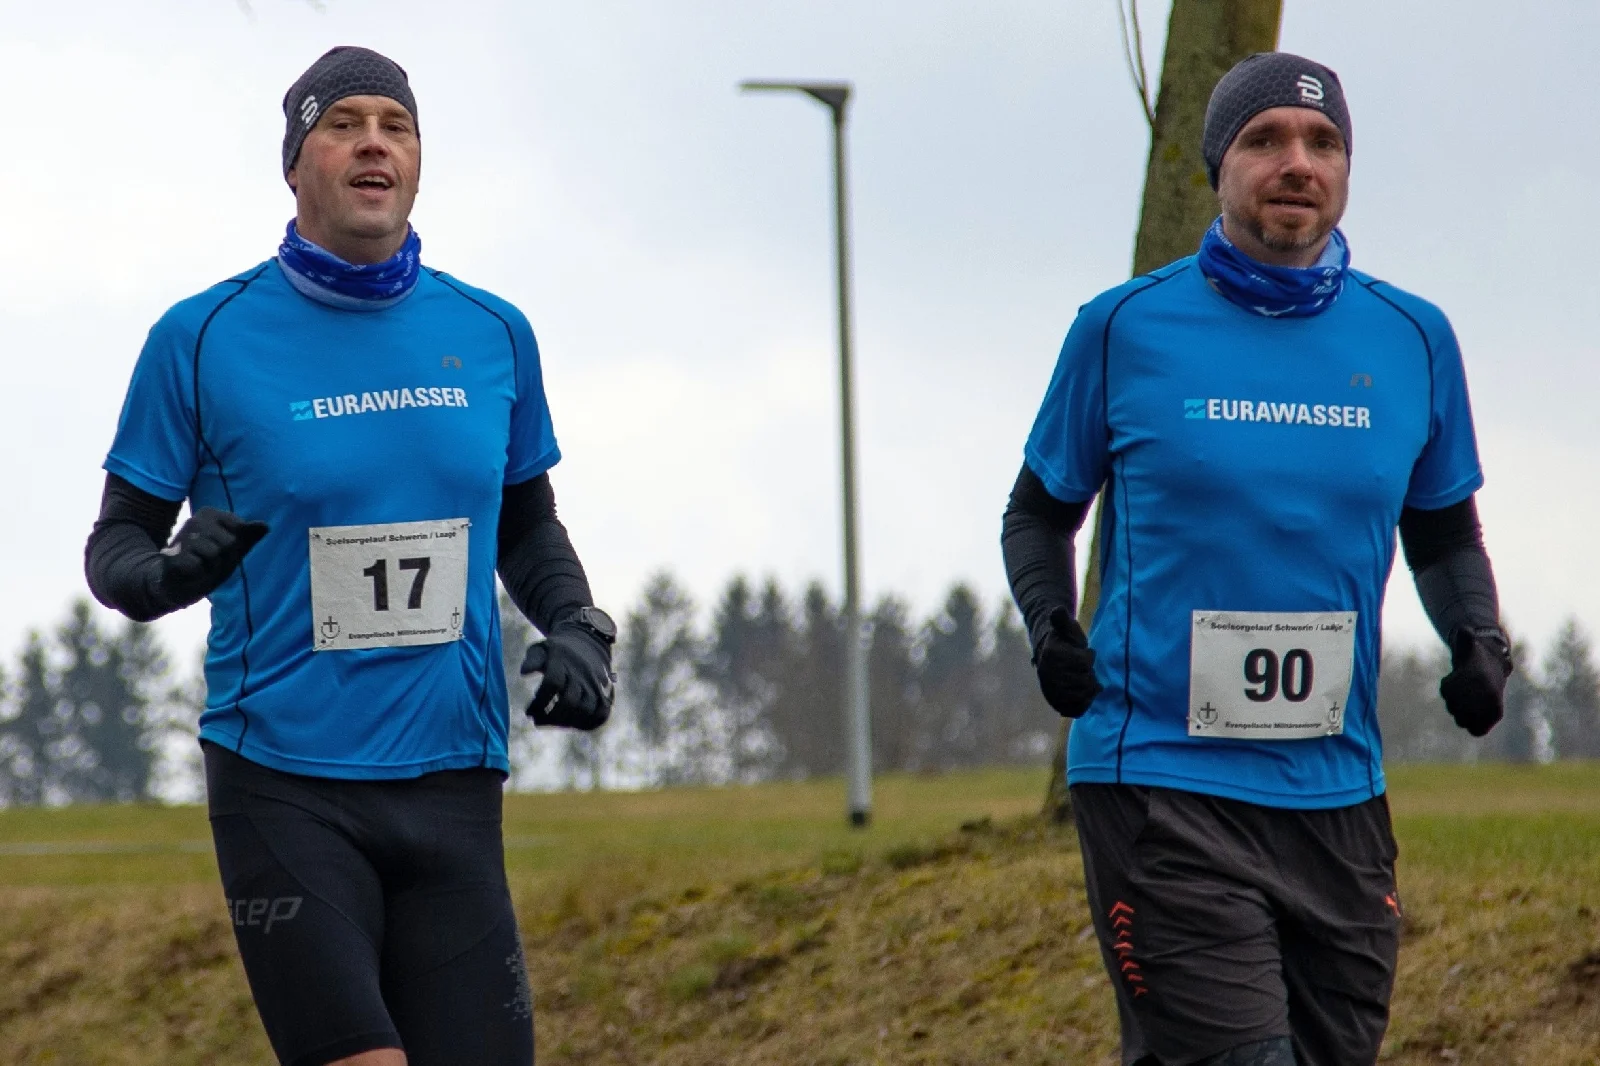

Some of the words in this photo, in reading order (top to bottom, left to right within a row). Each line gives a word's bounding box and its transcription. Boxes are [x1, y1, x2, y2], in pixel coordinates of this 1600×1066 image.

[312, 387, 469, 419] EURAWASSER
[1207, 398, 1372, 429] EURAWASSER
[363, 556, 431, 612] 17
[1243, 648, 1315, 703] 90
